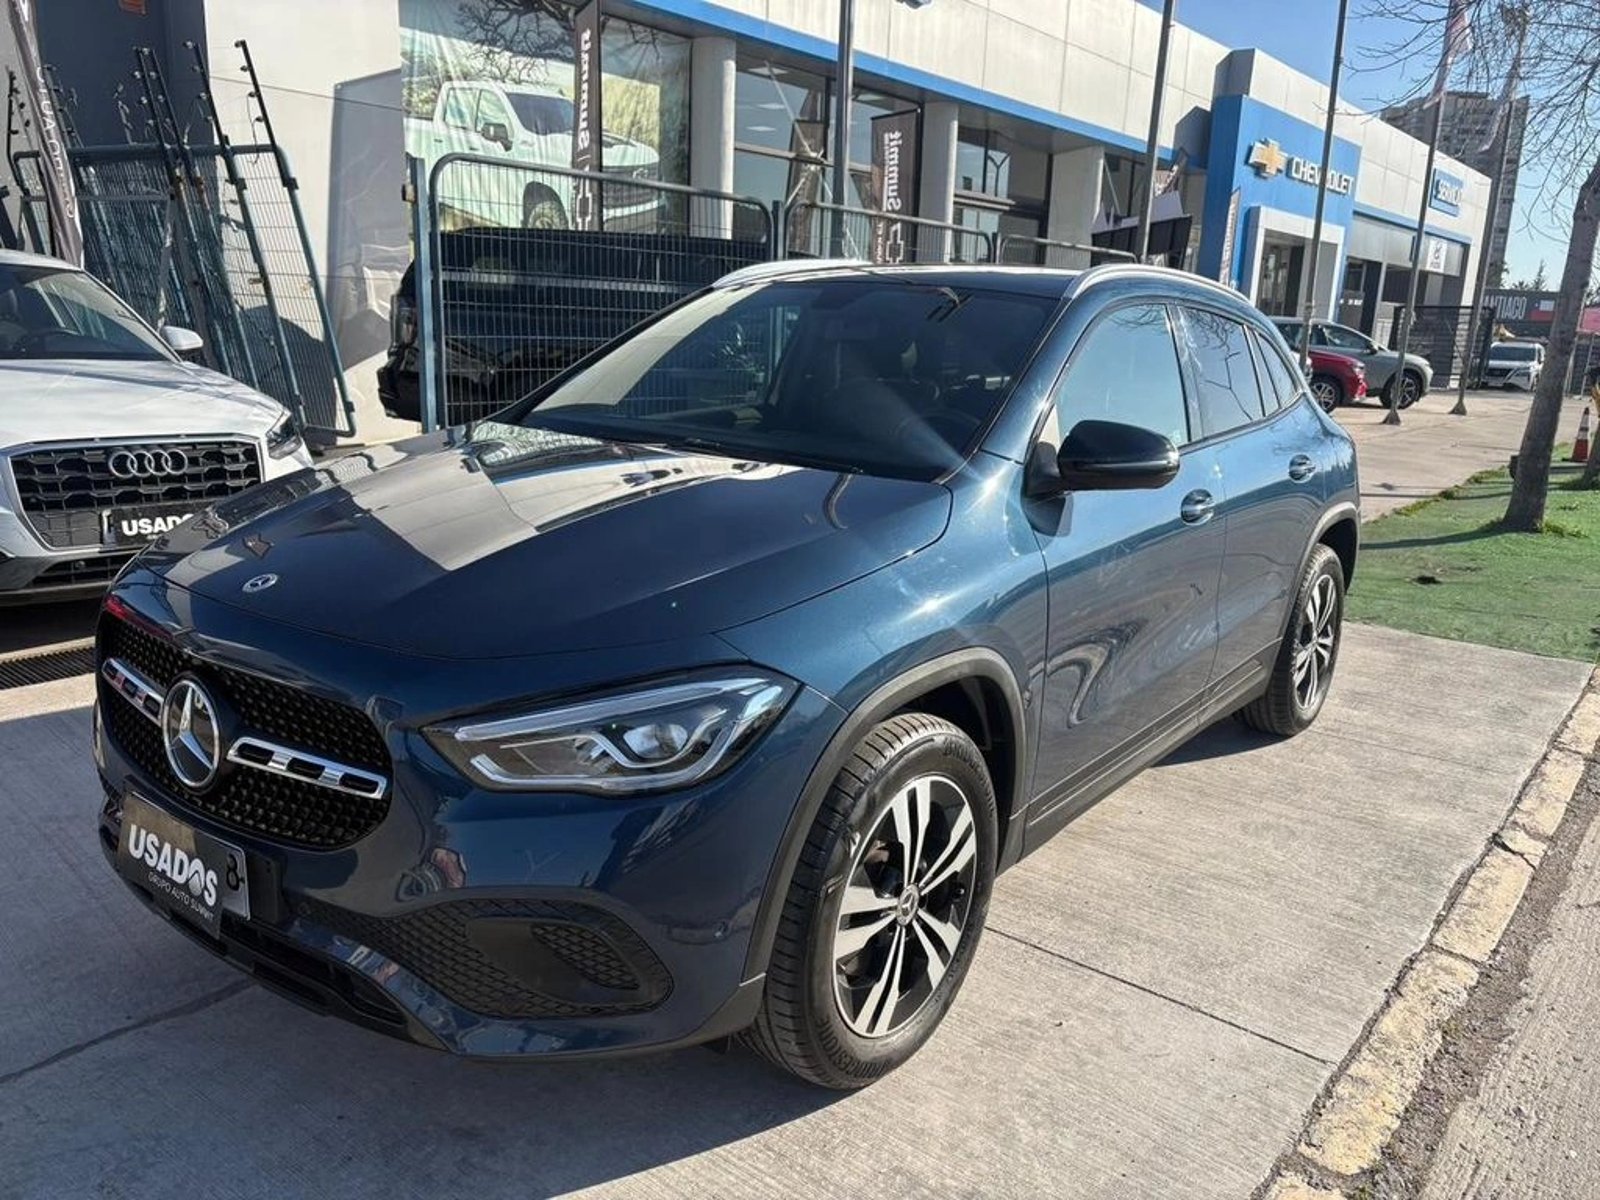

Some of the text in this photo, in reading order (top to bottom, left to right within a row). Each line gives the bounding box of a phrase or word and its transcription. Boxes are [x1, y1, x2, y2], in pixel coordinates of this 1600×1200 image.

[1291, 156, 1354, 197] CHEVOLET
[128, 823, 218, 907] USADOS
[148, 871, 214, 922] GRUPO AUTO SUMMIT
